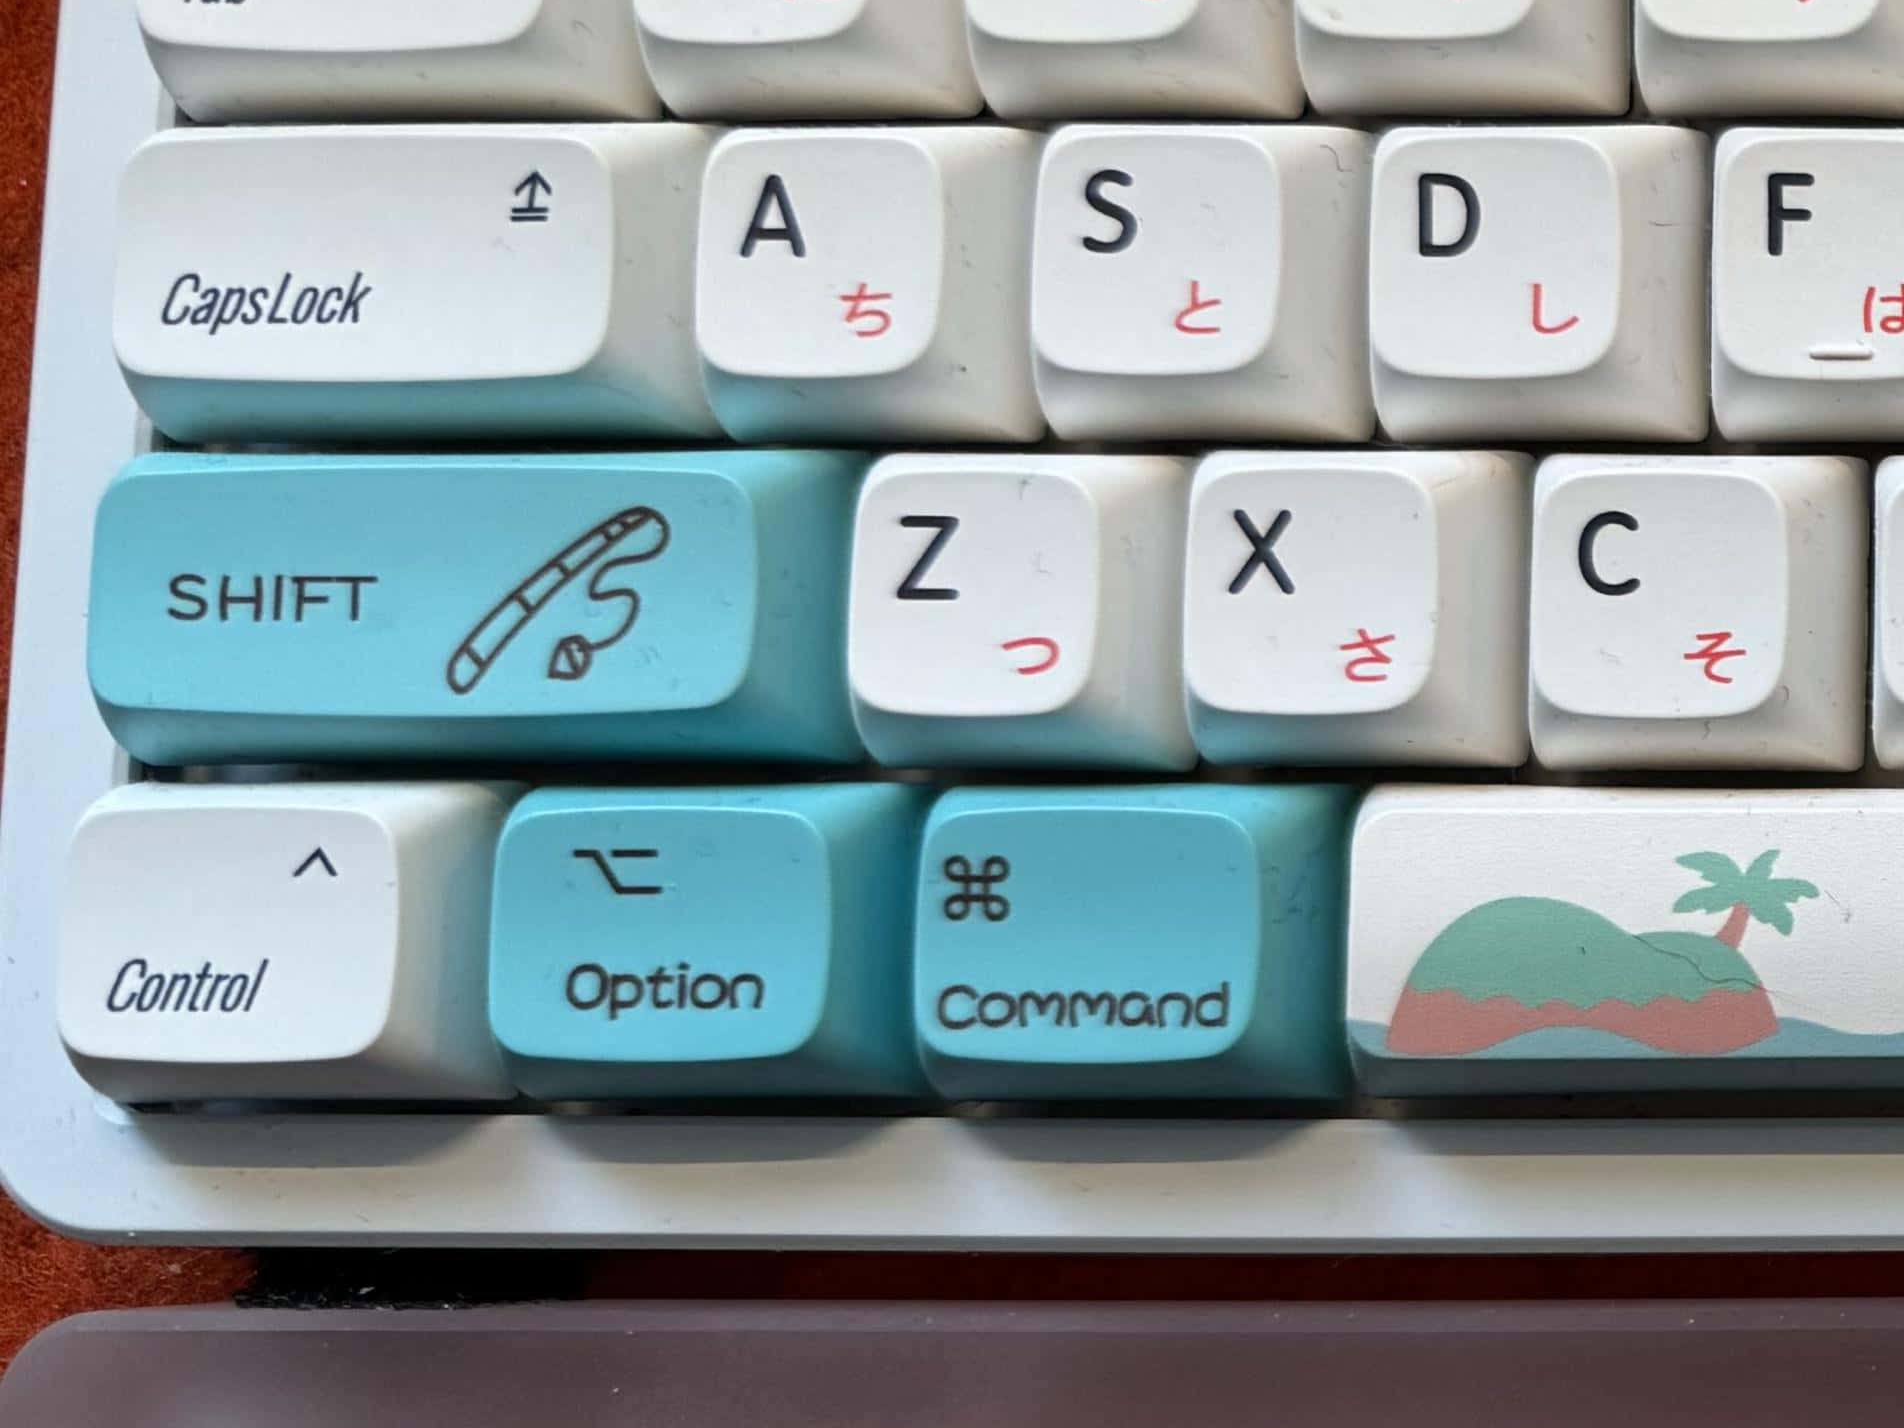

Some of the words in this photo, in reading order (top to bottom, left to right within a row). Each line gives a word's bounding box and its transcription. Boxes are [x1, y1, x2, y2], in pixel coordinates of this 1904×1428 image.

[738, 172, 806, 259] A
[1080, 167, 1138, 255] S
[1416, 171, 1482, 259] D
[1765, 171, 1816, 258] F
[160, 270, 373, 337] CapsLock
[837, 281, 893, 340] ち
[1171, 279, 1222, 337] と
[1529, 281, 1580, 337] し
[894, 514, 960, 602] Z
[1226, 508, 1296, 596] X
[1576, 509, 1642, 598] C
[166, 572, 380, 623] SHIFT
[999, 634, 1062, 677] つ
[1338, 627, 1395, 685] さ
[1683, 630, 1746, 686] そ
[105, 957, 271, 1014] Control
[563, 960, 766, 1022] Option
[934, 980, 1231, 1032] Command
